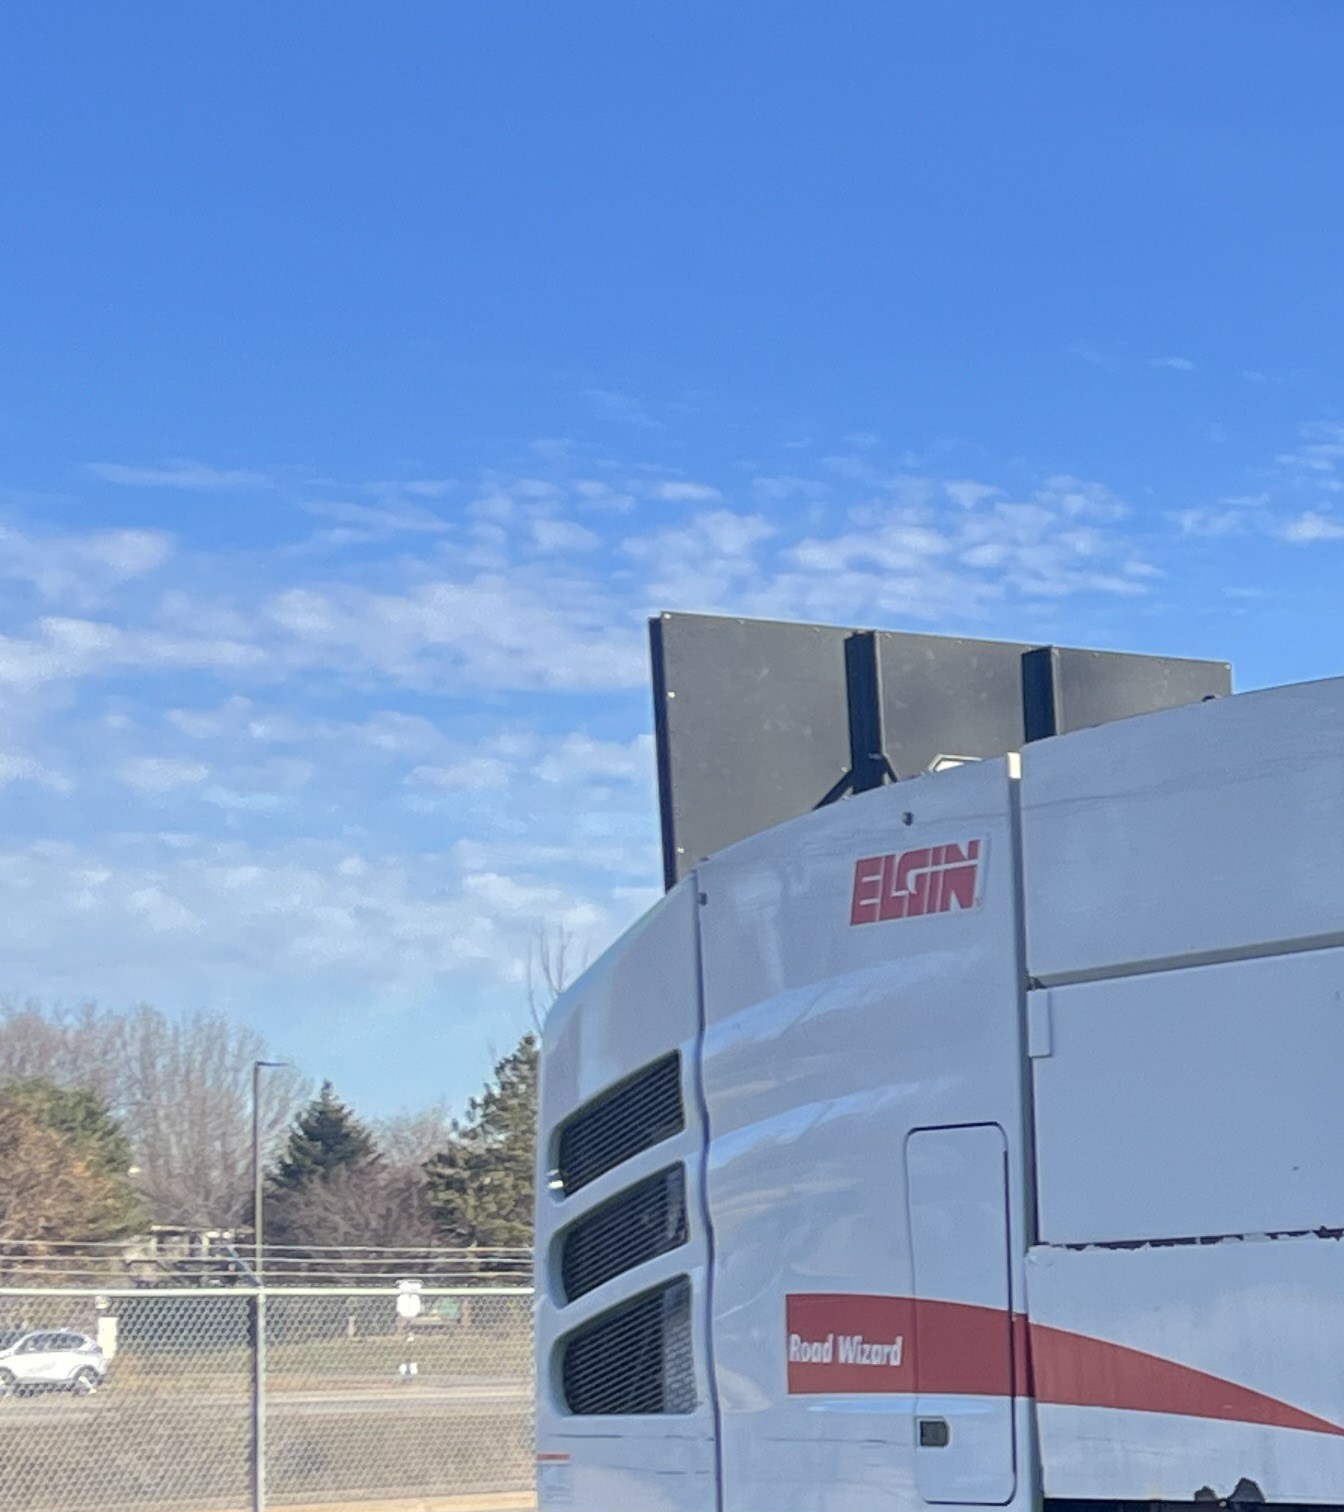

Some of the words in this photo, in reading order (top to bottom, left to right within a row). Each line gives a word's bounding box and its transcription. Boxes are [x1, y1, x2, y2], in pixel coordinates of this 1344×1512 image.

[850, 838, 981, 926] ELGIN
[789, 1333, 834, 1363] Road
[838, 1335, 903, 1366] Wizard
